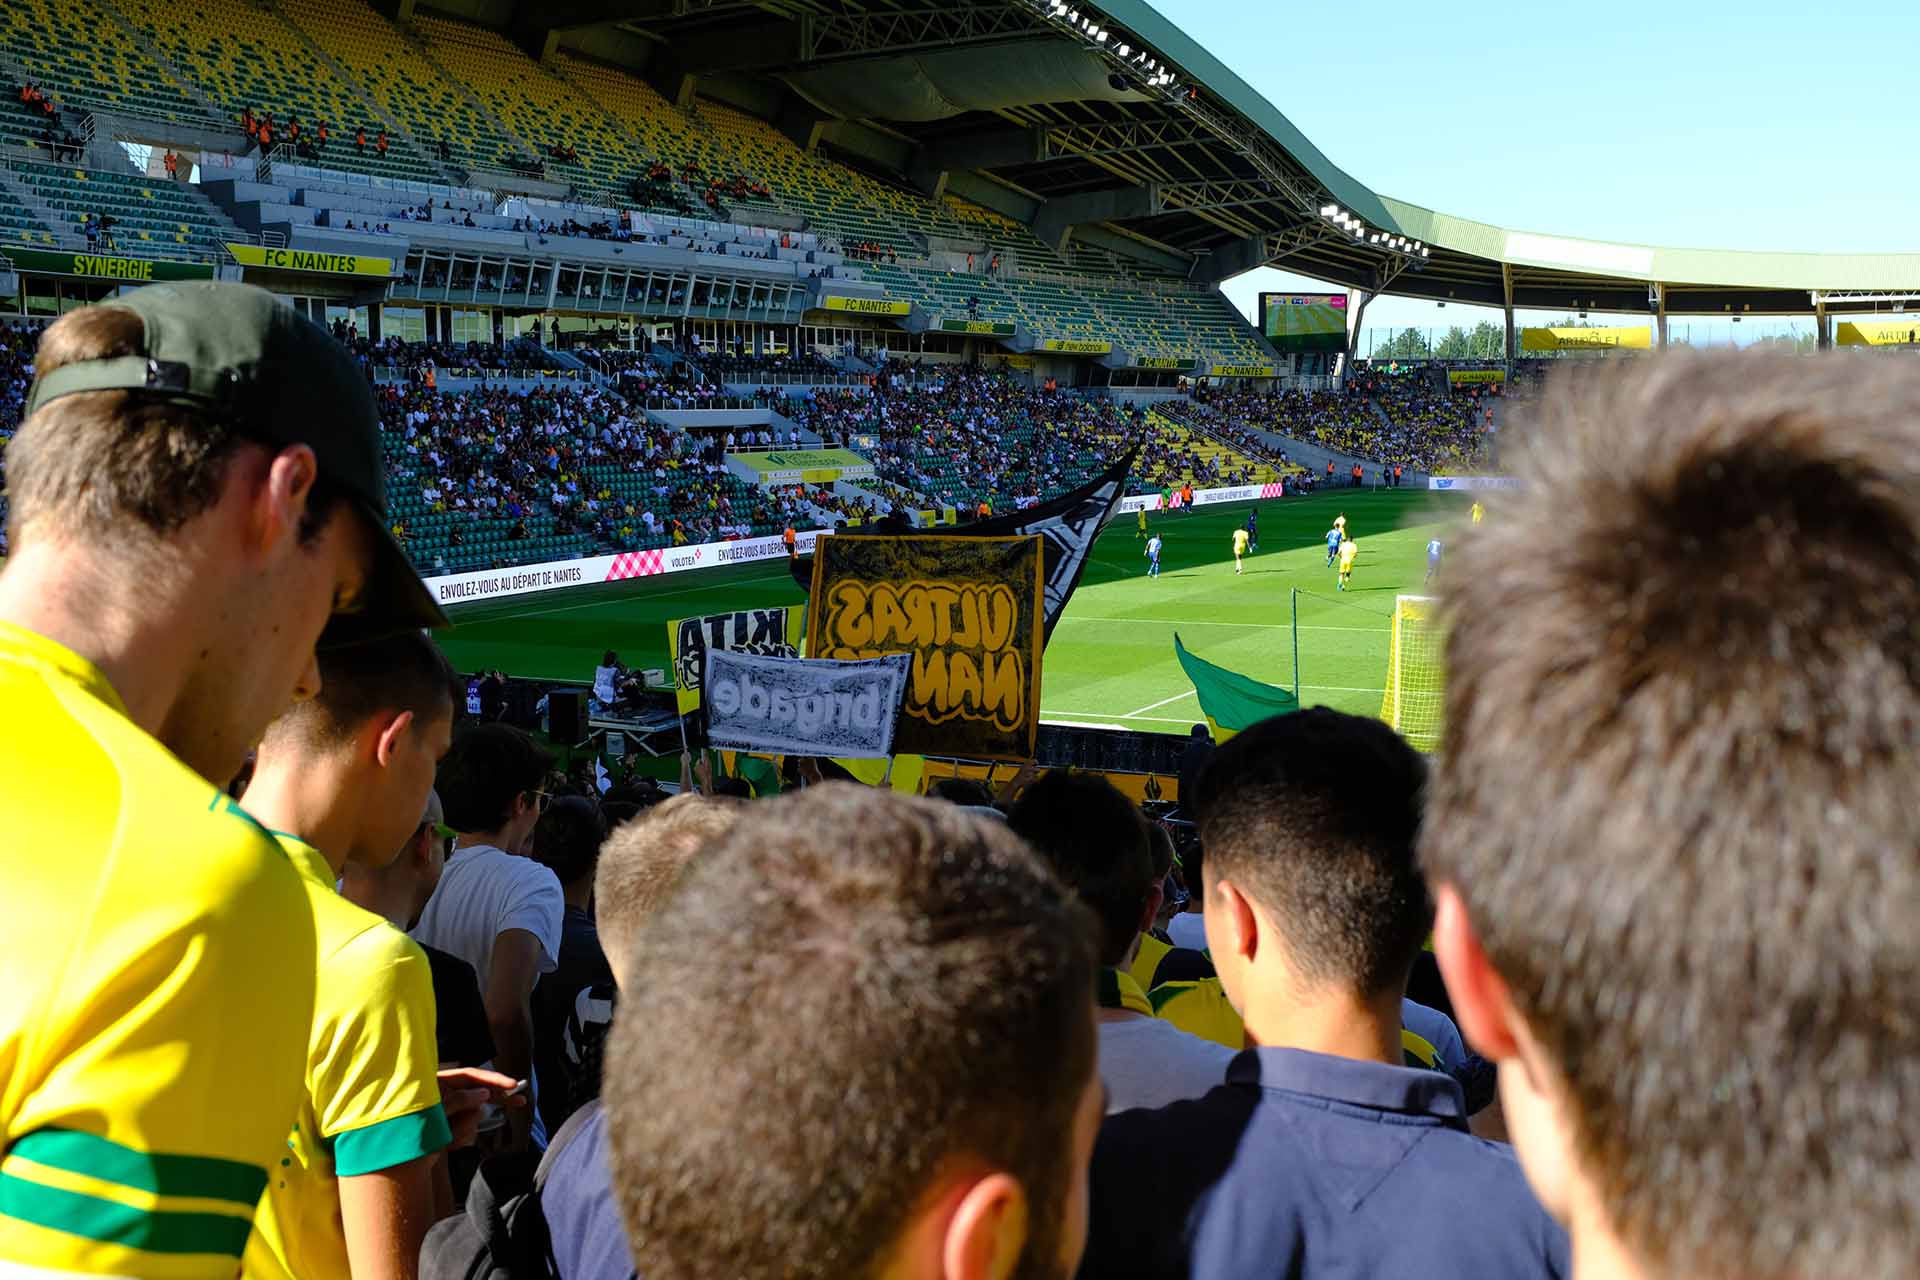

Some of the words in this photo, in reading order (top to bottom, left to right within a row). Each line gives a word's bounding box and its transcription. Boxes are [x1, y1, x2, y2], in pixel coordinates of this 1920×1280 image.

[72, 255, 153, 281] SYNERGIE
[264, 250, 288, 267] FC
[292, 252, 356, 273] NANTES
[845, 299, 857, 311] FC
[859, 301, 893, 313] NANTES
[1154, 358, 1178, 369] NANTES
[1222, 366, 1233, 375] FC
[1234, 366, 1264, 376] NANTES
[718, 544, 759, 562] ENVOLEZ-VOUS
[759, 543, 767, 556] AU
[671, 556, 696, 568] VOLOTEA
[440, 578, 499, 600] ENVOLEZ-VOUS
[500, 576, 511, 591] AU
[513, 572, 541, 589] DÉPART
[542, 571, 552, 585] DE
[553, 567, 582, 583] NANTES
